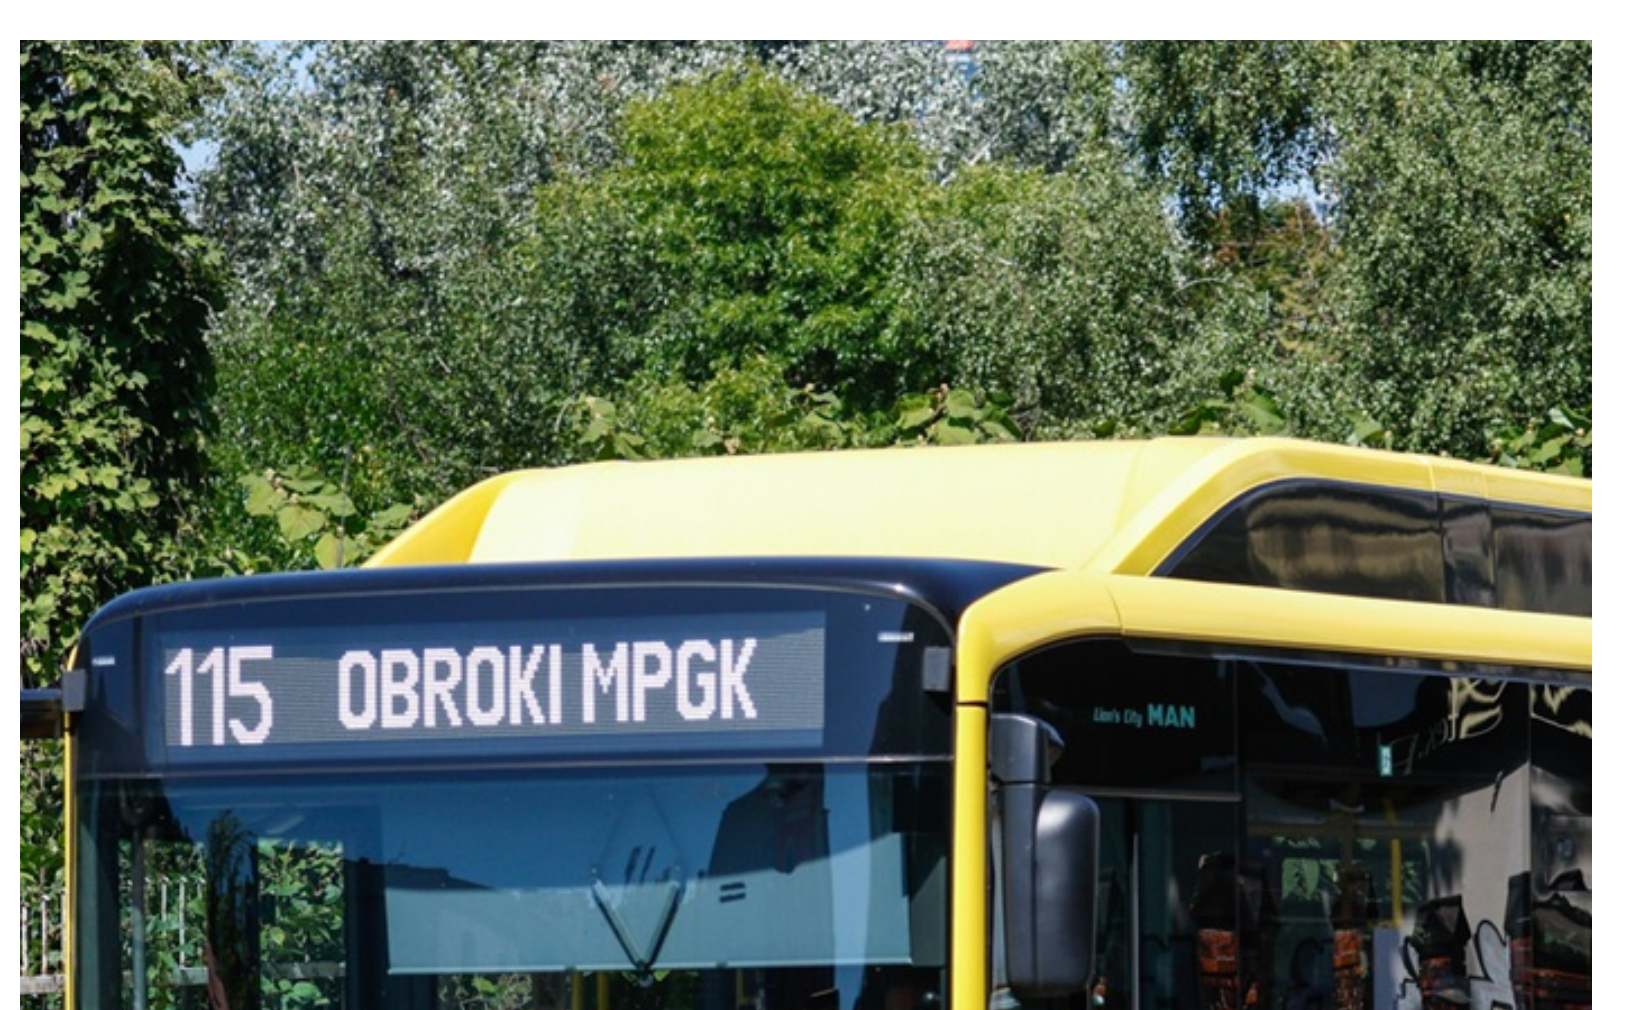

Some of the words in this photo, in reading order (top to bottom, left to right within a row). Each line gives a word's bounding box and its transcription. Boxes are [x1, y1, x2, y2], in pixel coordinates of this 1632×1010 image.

[164, 644, 274, 746] 115
[336, 642, 562, 730] OBROKI
[581, 637, 758, 724] MPGK
[1147, 703, 1196, 729] MAN
